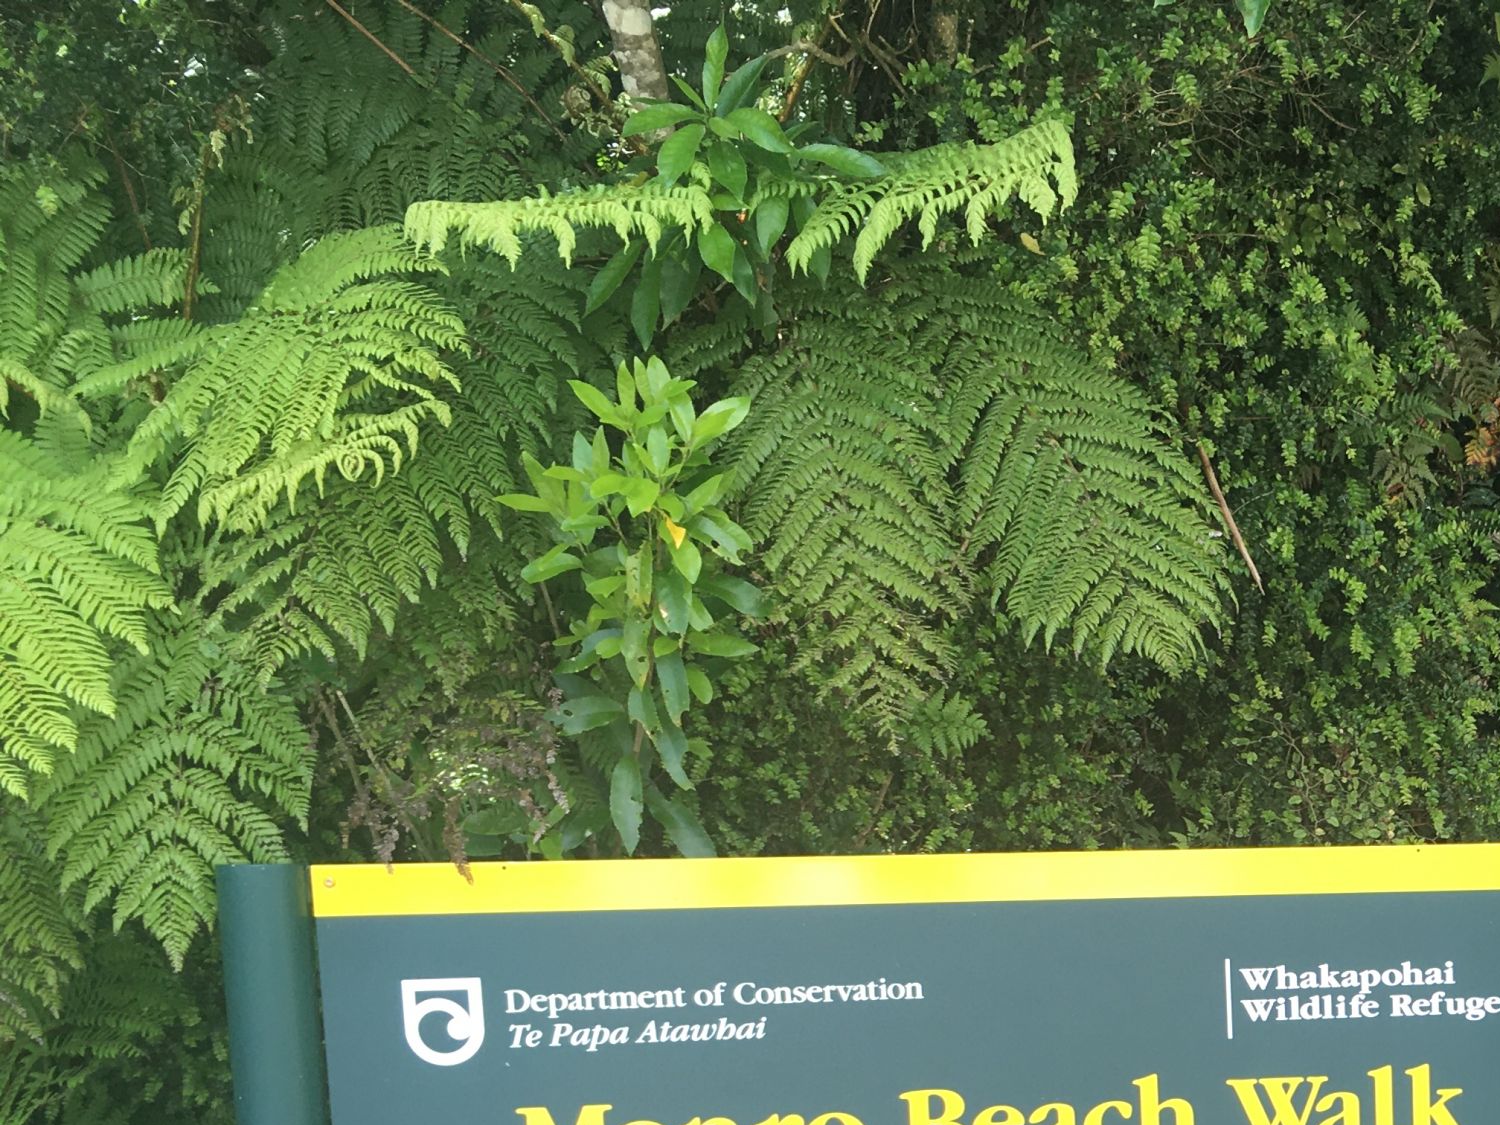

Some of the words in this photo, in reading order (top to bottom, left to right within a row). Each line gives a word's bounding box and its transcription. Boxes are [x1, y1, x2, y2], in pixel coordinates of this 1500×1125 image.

[1238, 960, 1457, 995] Whakapohai
[503, 987, 688, 1018] Department
[693, 981, 727, 1007] of
[732, 977, 925, 1006] Conservation
[1239, 993, 1380, 1023] Wildlife
[508, 1023, 544, 1049] Te
[548, 1023, 630, 1052] Papa
